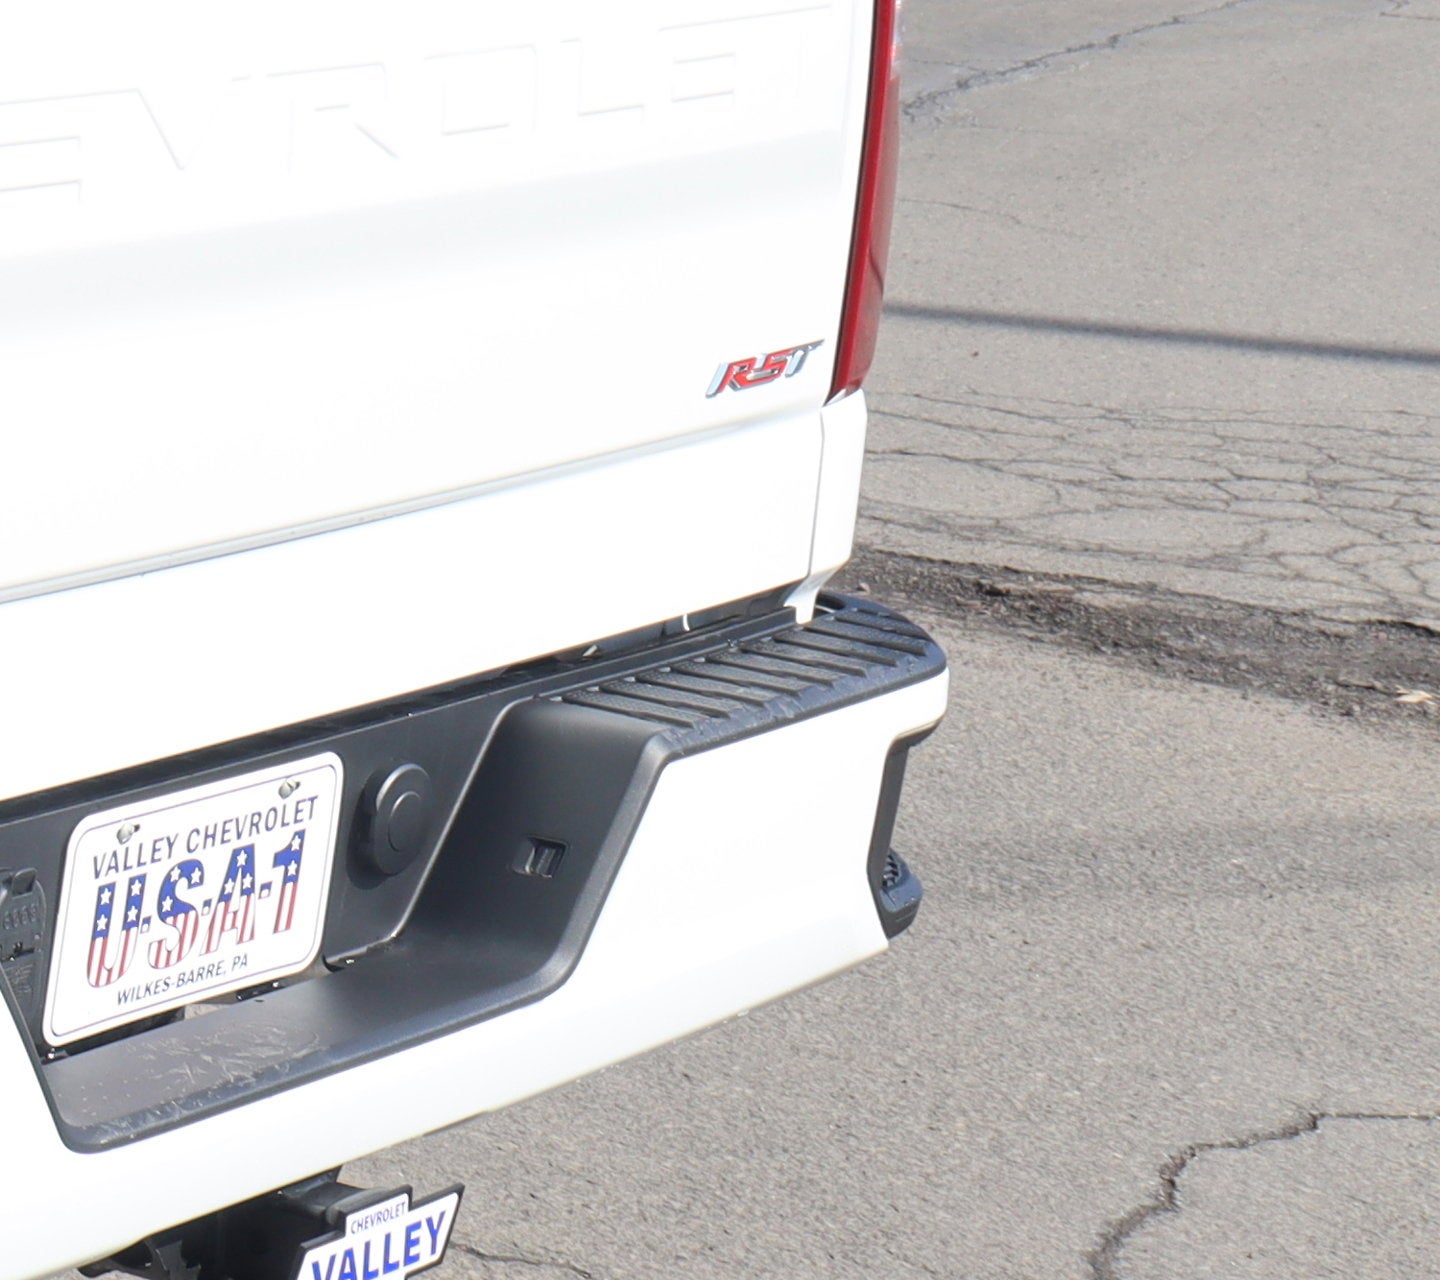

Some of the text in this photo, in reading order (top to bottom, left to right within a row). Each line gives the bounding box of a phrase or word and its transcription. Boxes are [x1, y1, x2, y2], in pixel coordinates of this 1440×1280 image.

[705, 338, 825, 398] RST
[93, 795, 319, 879] VALLEY CHEVROLET
[117, 953, 248, 1005] WILKES-BARRE, PA
[350, 1202, 406, 1234] CHEVROLET
